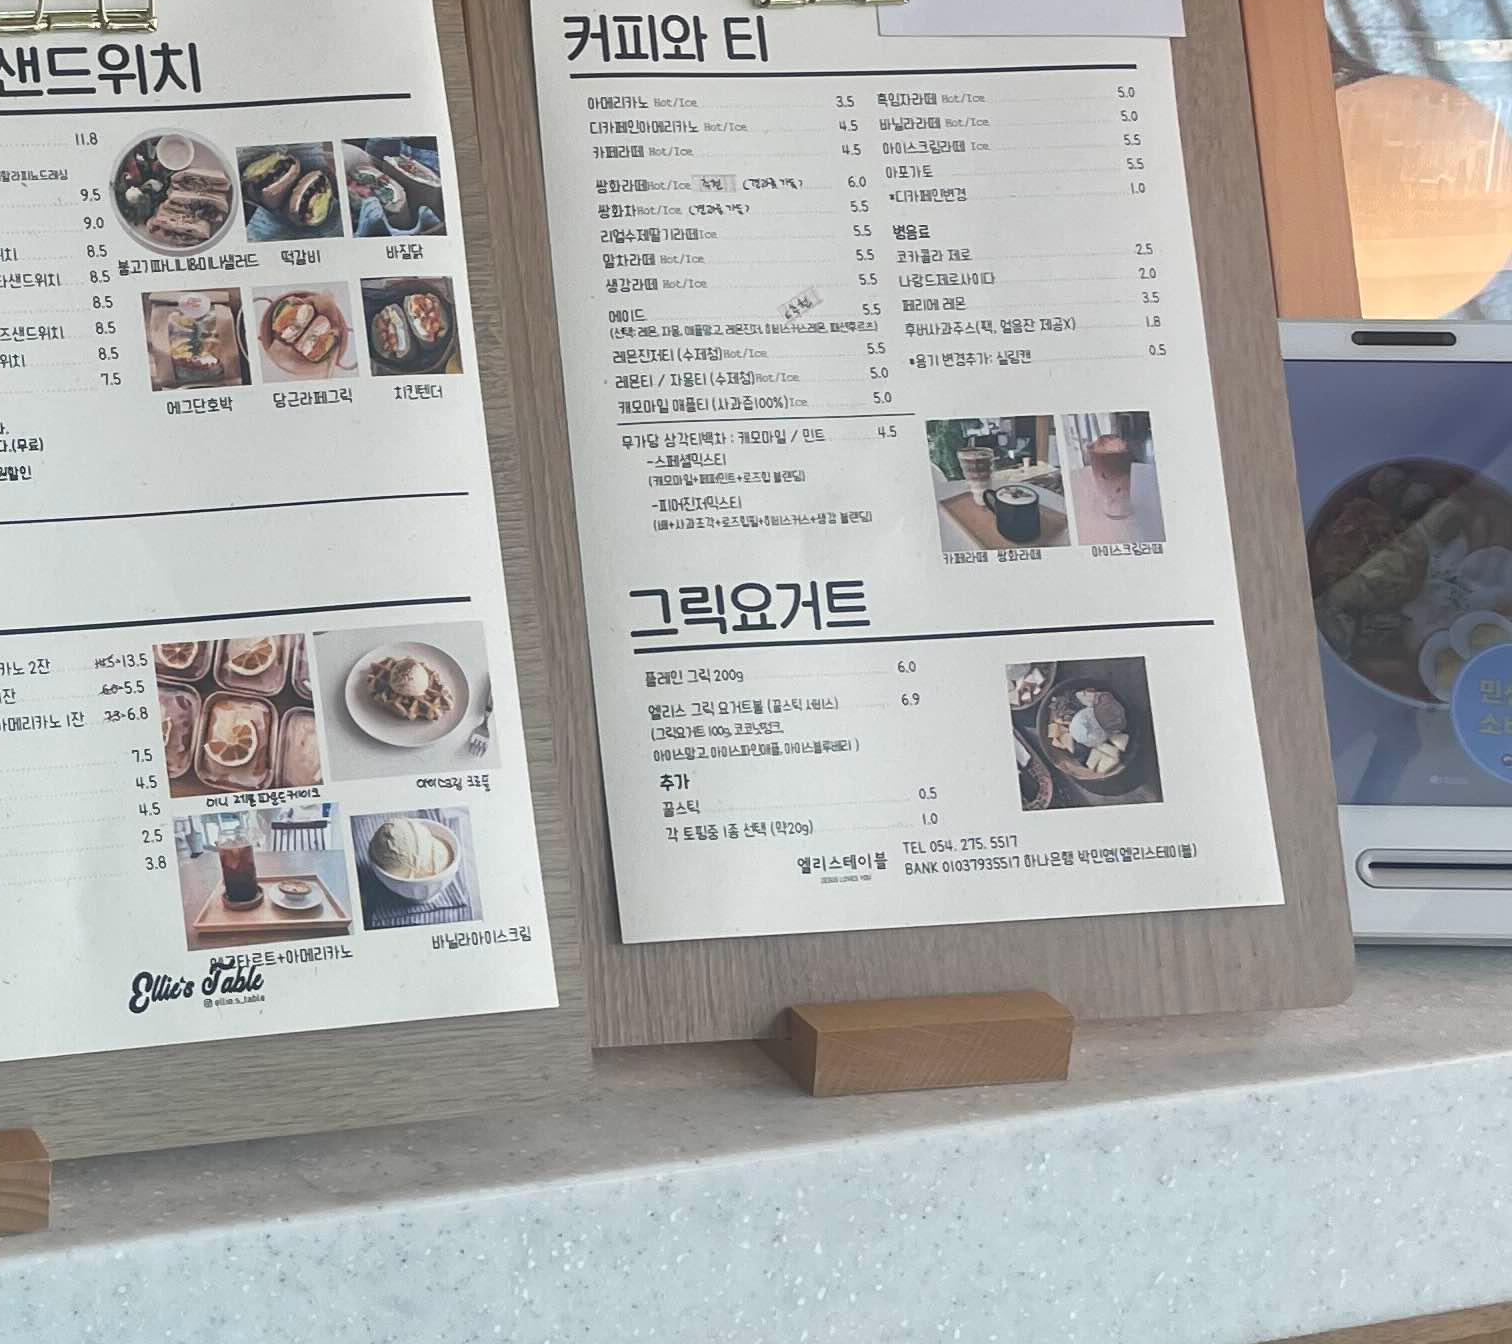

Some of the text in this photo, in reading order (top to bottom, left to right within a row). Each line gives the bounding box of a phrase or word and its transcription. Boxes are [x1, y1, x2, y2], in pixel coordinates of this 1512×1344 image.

[563, 14, 769, 62] 커피와 티
[587, 97, 649, 110] 아메리카노
[836, 96, 855, 108] 3.5
[74, 132, 98, 146] 11.8
[593, 146, 644, 159] 카페라떼
[842, 143, 862, 156] 4.5
[885, 158, 1145, 179] 아포가토 5.5
[83, 217, 105, 230] 9.0
[893, 225, 931, 241] 병음료
[281, 244, 424, 266] 떡갈비 바질닭
[100, 373, 122, 386] 7.5
[166, 385, 444, 416] 에그단호박 당근라페그릭 치킨텐더
[629, 580, 871, 638] 그릭요거트
[645, 661, 917, 687] 플레인 그릭 200g 6.0
[131, 748, 153, 763] 7.5
[135, 776, 158, 789] 4.5
[659, 773, 690, 791] 추가
[138, 803, 161, 816] 4.5
[141, 829, 163, 843] 2.5
[902, 835, 1018, 855] TEL 054. 275. 5517
[145, 855, 167, 870] 3.8
[797, 852, 888, 874] 엘리스테이블
[904, 856, 1021, 875] BANK 01037935517
[432, 926, 532, 951] 바닐라아이스크림
[200, 967, 265, 996] Table
